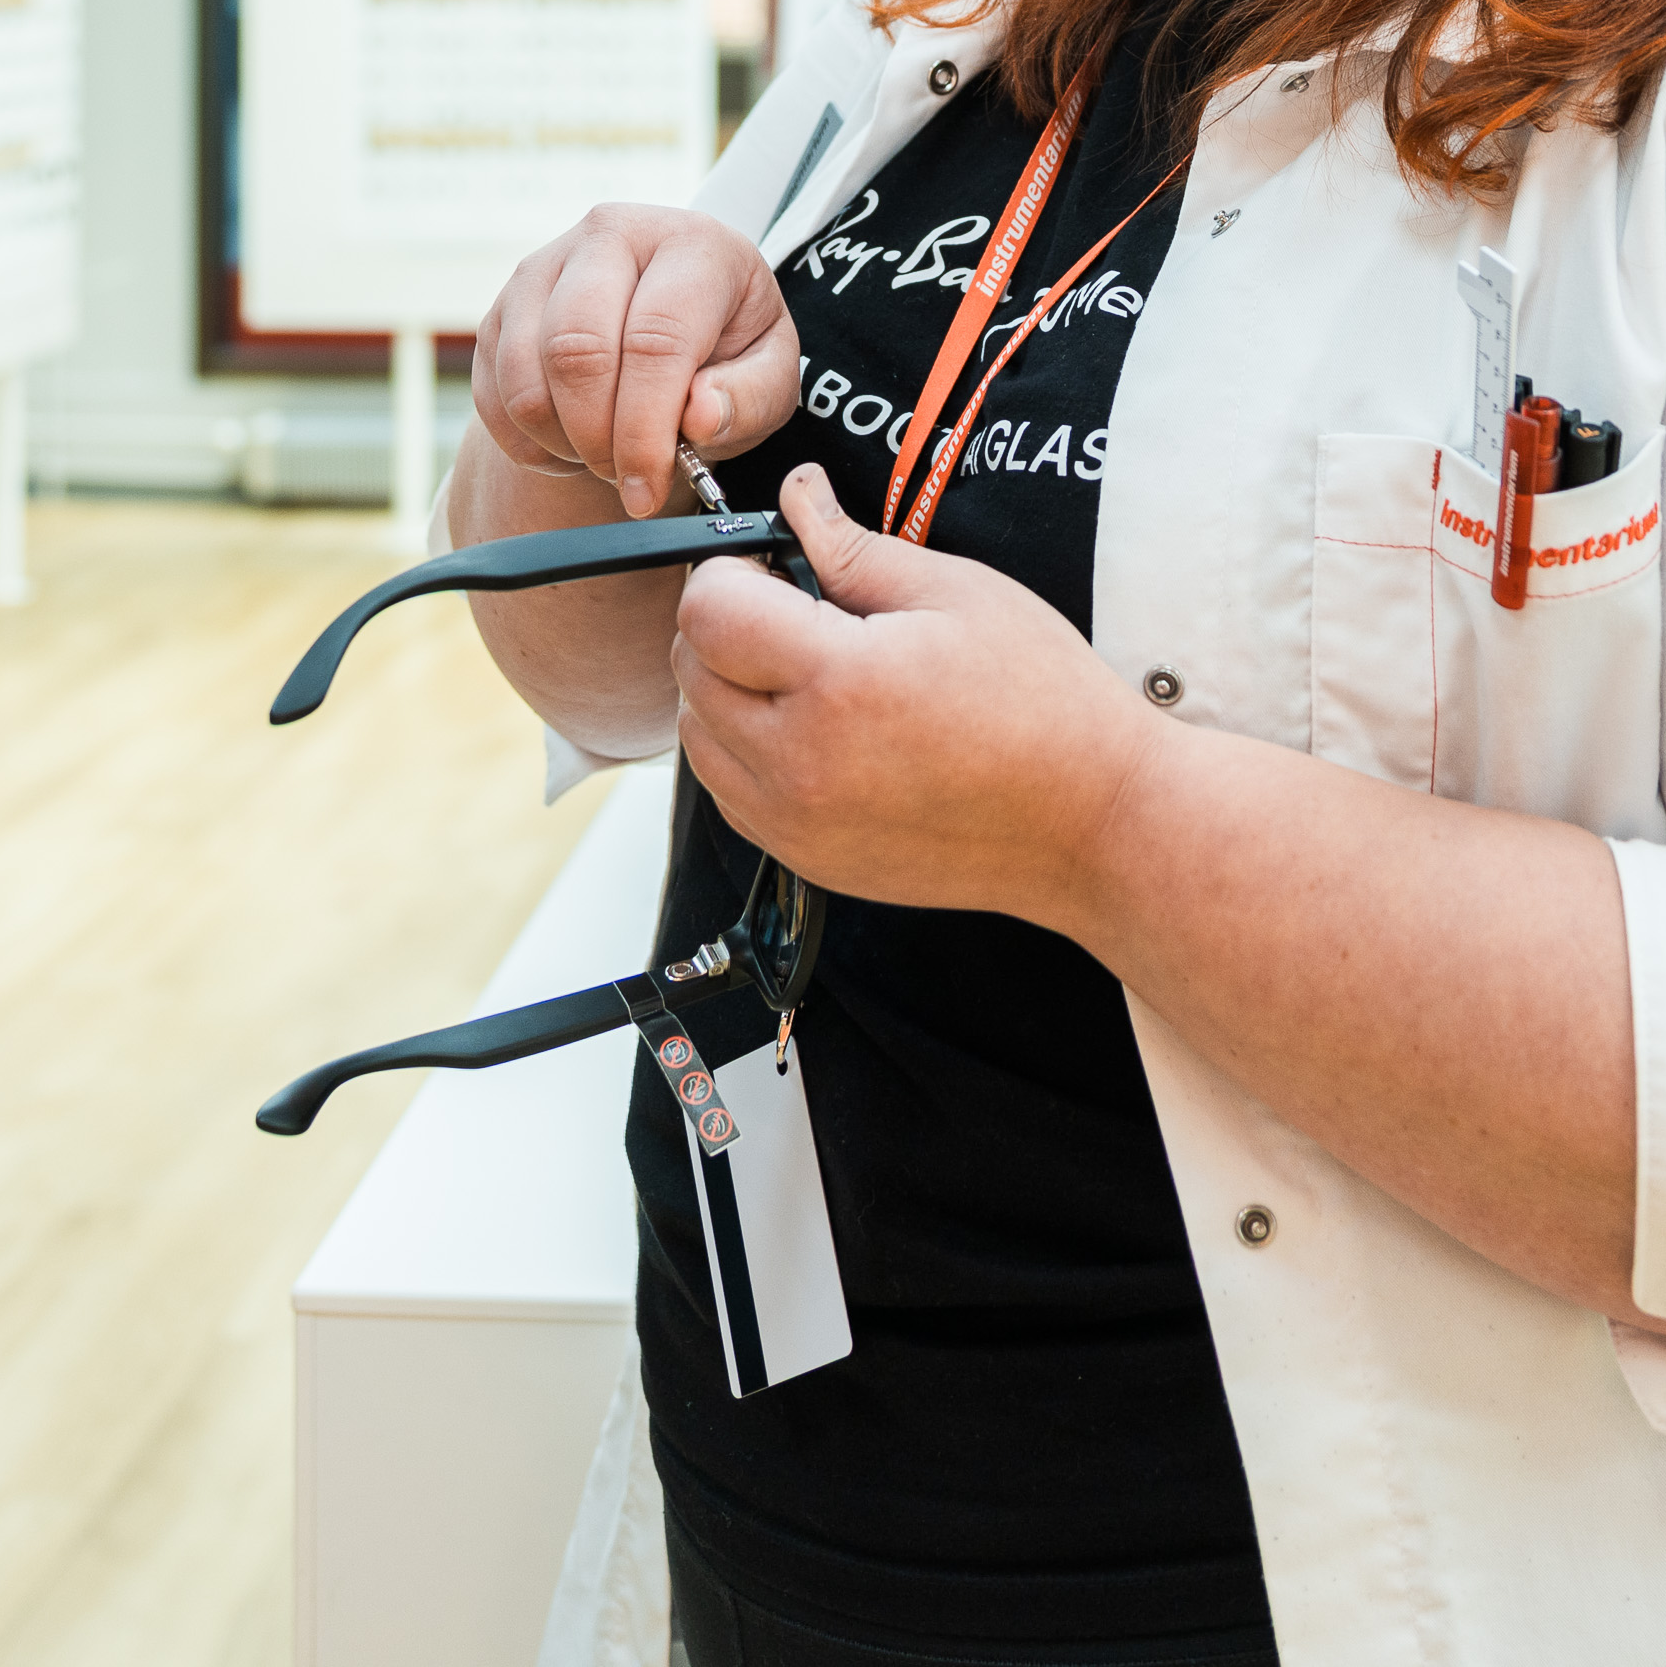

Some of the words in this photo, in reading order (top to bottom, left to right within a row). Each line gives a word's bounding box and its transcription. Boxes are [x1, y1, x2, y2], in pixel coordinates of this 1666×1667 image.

[976, 89, 1083, 298] instrumentarium
[903, 303, 1044, 543] instrumentarium
[1440, 498, 1660, 569] instrentarium
[1498, 448, 1520, 578] instrumentarium
